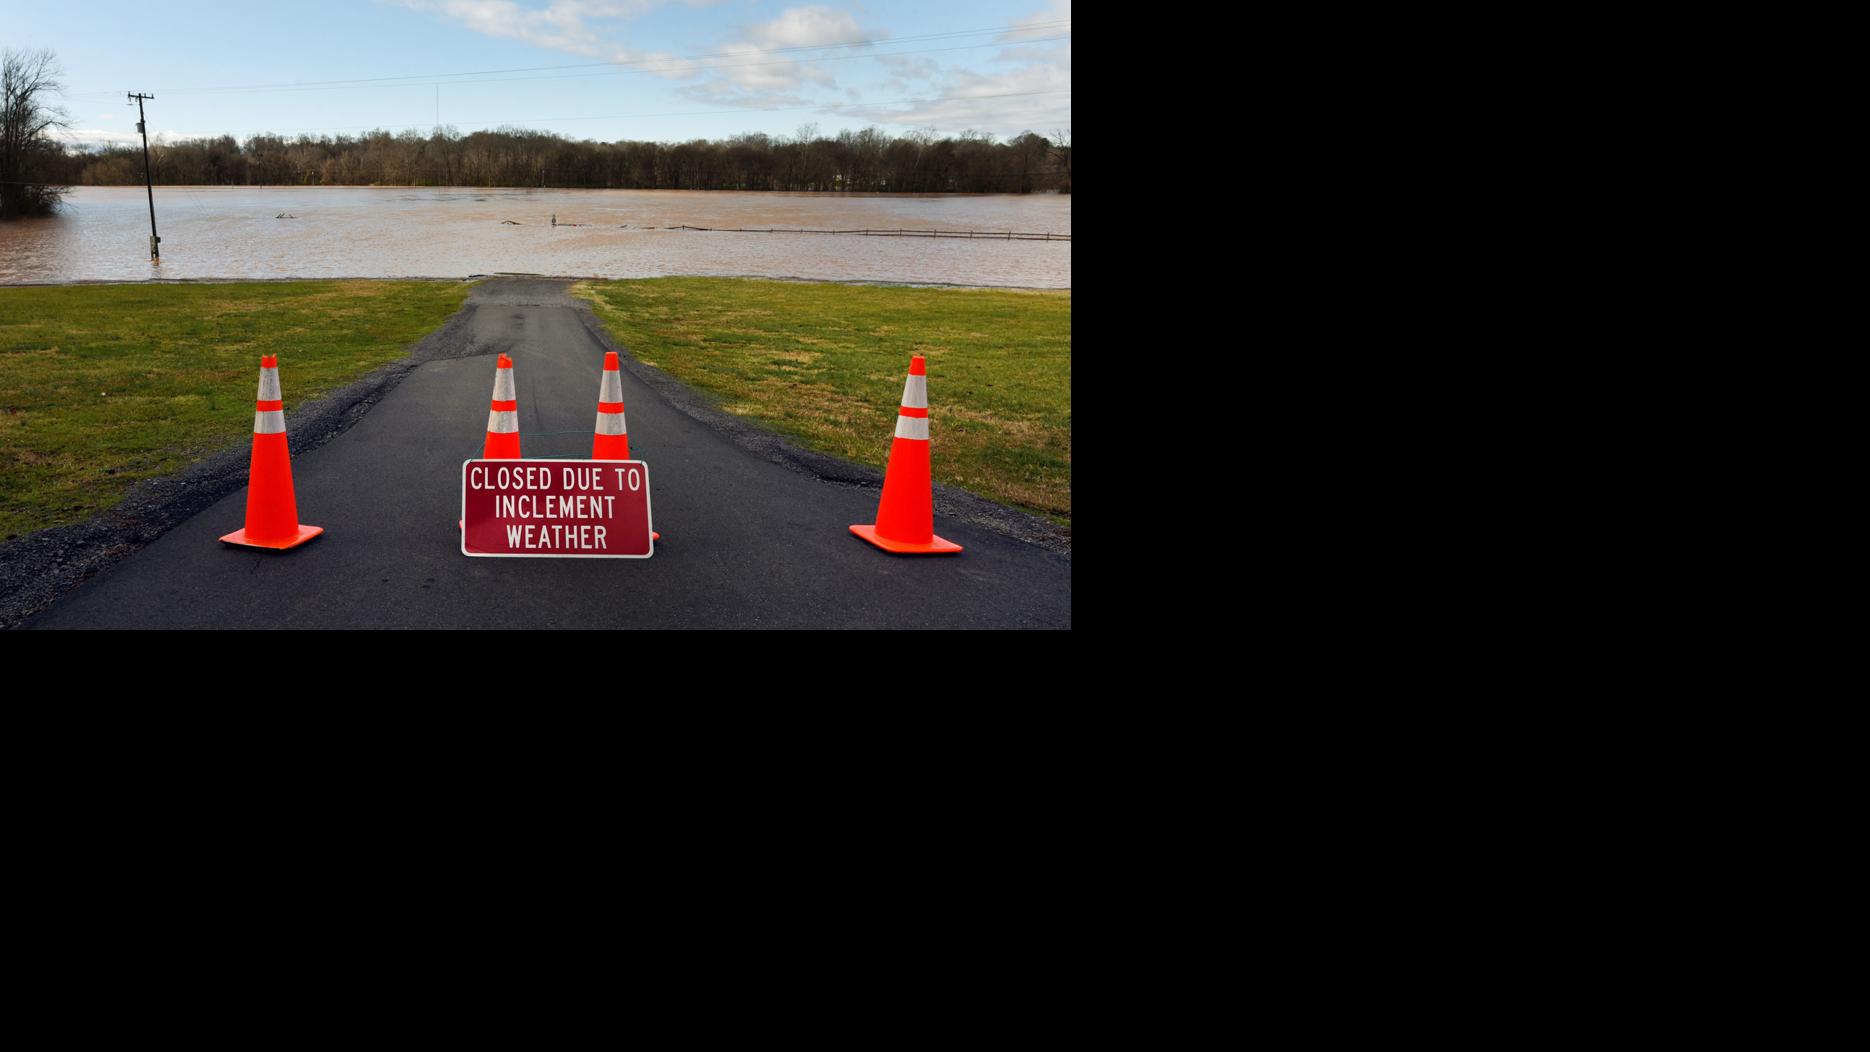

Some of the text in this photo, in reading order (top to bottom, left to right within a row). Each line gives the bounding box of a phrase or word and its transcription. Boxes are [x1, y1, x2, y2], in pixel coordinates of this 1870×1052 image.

[470, 466, 641, 492] CLOSED DUE TO
[495, 495, 616, 519] INCLEMENT
[506, 524, 607, 549] WEATHER
